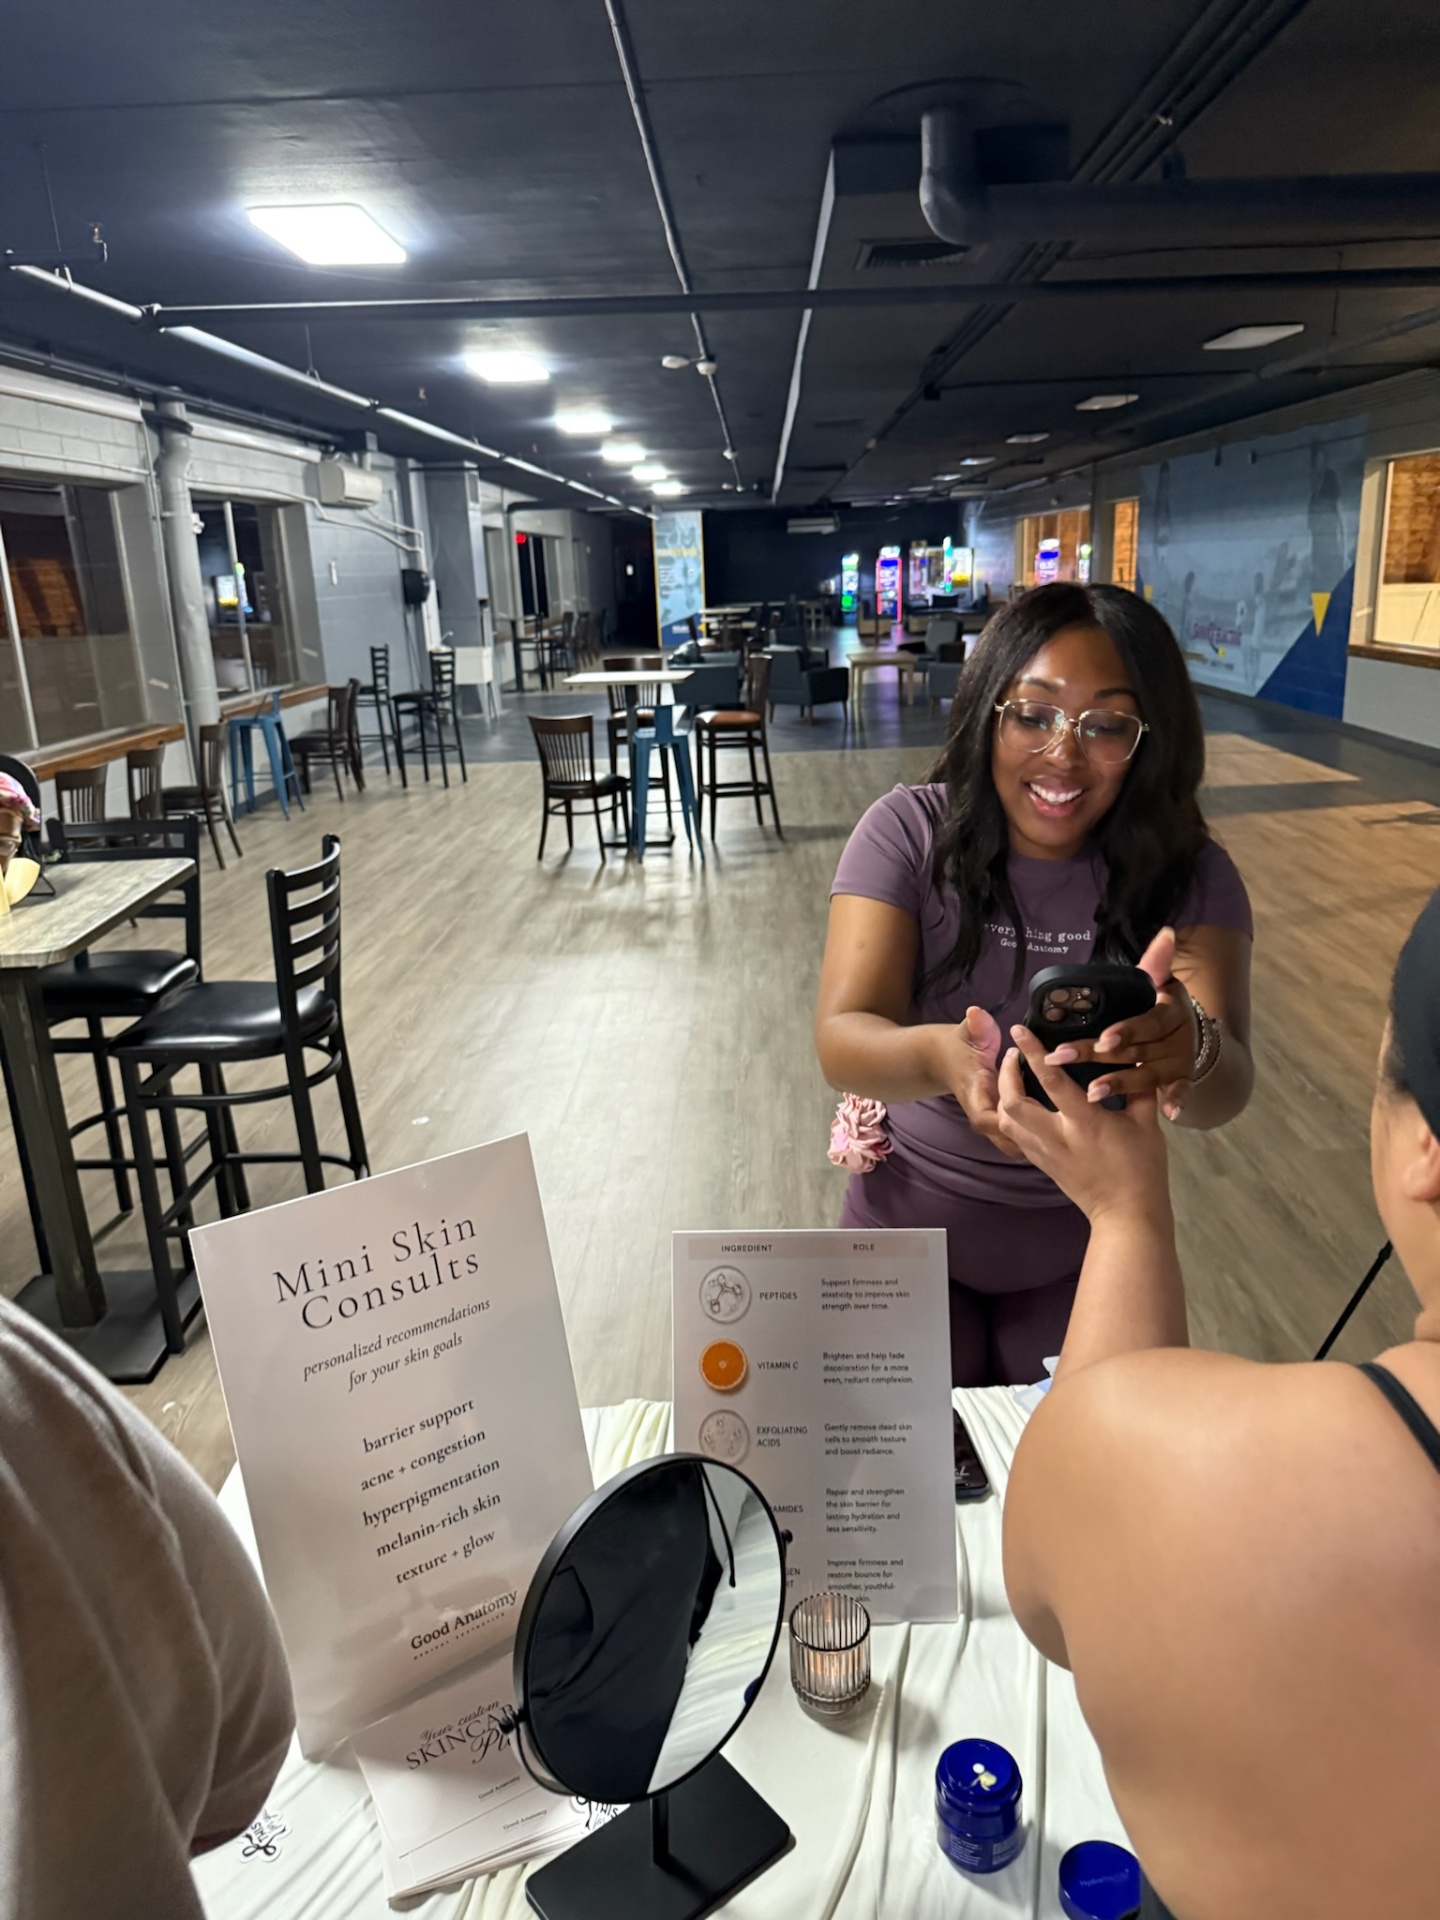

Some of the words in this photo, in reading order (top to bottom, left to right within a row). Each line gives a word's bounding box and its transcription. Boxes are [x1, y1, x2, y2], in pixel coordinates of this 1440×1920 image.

[984, 923, 1053, 942] veryhing
[1058, 930, 1091, 942] good
[1000, 938, 1017, 948] Goo
[1026, 942, 1069, 954] Anatomy
[721, 1244, 773, 1252] INGREDIENT
[853, 1243, 875, 1251] ROLE
[272, 1245, 374, 1304] Mini
[391, 1218, 477, 1262] Skin
[821, 1278, 850, 1287] Support
[852, 1278, 882, 1286] firmness
[884, 1278, 898, 1286] and
[301, 1252, 479, 1330] Consults
[759, 1292, 798, 1300] PEPTIDES
[821, 1290, 852, 1299] elasticity
[864, 1291, 894, 1300] improve
[821, 1302, 852, 1311] strength
[871, 1302, 889, 1310] time.
[303, 1335, 383, 1382] personalized
[386, 1299, 491, 1347] recommendations
[823, 1352, 854, 1361] Brighten
[855, 1352, 869, 1360] and
[870, 1352, 887, 1361] help
[888, 1352, 905, 1360] fade
[348, 1370, 367, 1393] for
[371, 1359, 401, 1383] your
[404, 1346, 429, 1366] skin
[433, 1332, 463, 1360] goals
[757, 1362, 791, 1370] VITAMIN
[793, 1361, 799, 1369] C
[823, 1364, 869, 1372] discoloration
[871, 1364, 881, 1372] for
[823, 1377, 842, 1385] even,
[844, 1376, 869, 1384] radiant
[871, 1376, 914, 1386] complexion.
[362, 1424, 415, 1454] barrier
[419, 1399, 475, 1430] support
[757, 1426, 808, 1435] EXFOLIATING
[824, 1423, 849, 1433] Gently
[878, 1423, 897, 1431] dead
[898, 1423, 912, 1431] skin
[757, 1439, 781, 1447] ACIDS
[825, 1435, 840, 1443] cells
[852, 1435, 879, 1443] smooth
[880, 1435, 906, 1443] texture
[825, 1448, 838, 1456] and
[840, 1448, 860, 1456] boost
[862, 1447, 895, 1455] radiance.
[360, 1469, 395, 1491] acne
[398, 1466, 406, 1475] +
[410, 1430, 486, 1471] congestion
[362, 1460, 501, 1528] hyperpigmentation
[826, 1488, 849, 1497] Repair
[850, 1488, 864, 1496] and
[866, 1488, 905, 1497] strengthen
[769, 1505, 804, 1513] AMIDES
[826, 1500, 838, 1508] the
[839, 1500, 853, 1508] skin
[855, 1500, 879, 1508] barrier
[881, 1500, 891, 1508] for
[826, 1512, 850, 1521] lasting
[851, 1512, 885, 1522] hydration
[886, 1512, 900, 1520] and
[376, 1505, 470, 1557] melanin-rich
[473, 1494, 501, 1515] skin
[826, 1525, 840, 1533] less
[841, 1525, 878, 1534] sensitivity.
[396, 1553, 448, 1584] texture
[451, 1550, 459, 1558] +
[462, 1530, 496, 1558] glow
[827, 1559, 856, 1568] Improve
[828, 1583, 862, 1591] smoother,
[411, 1622, 450, 1650] Good
[454, 1590, 518, 1630] Anatomy
[419, 1724, 452, 1746] Your
[458, 1701, 499, 1726] custom
[406, 1703, 515, 1770] SKINCAR
